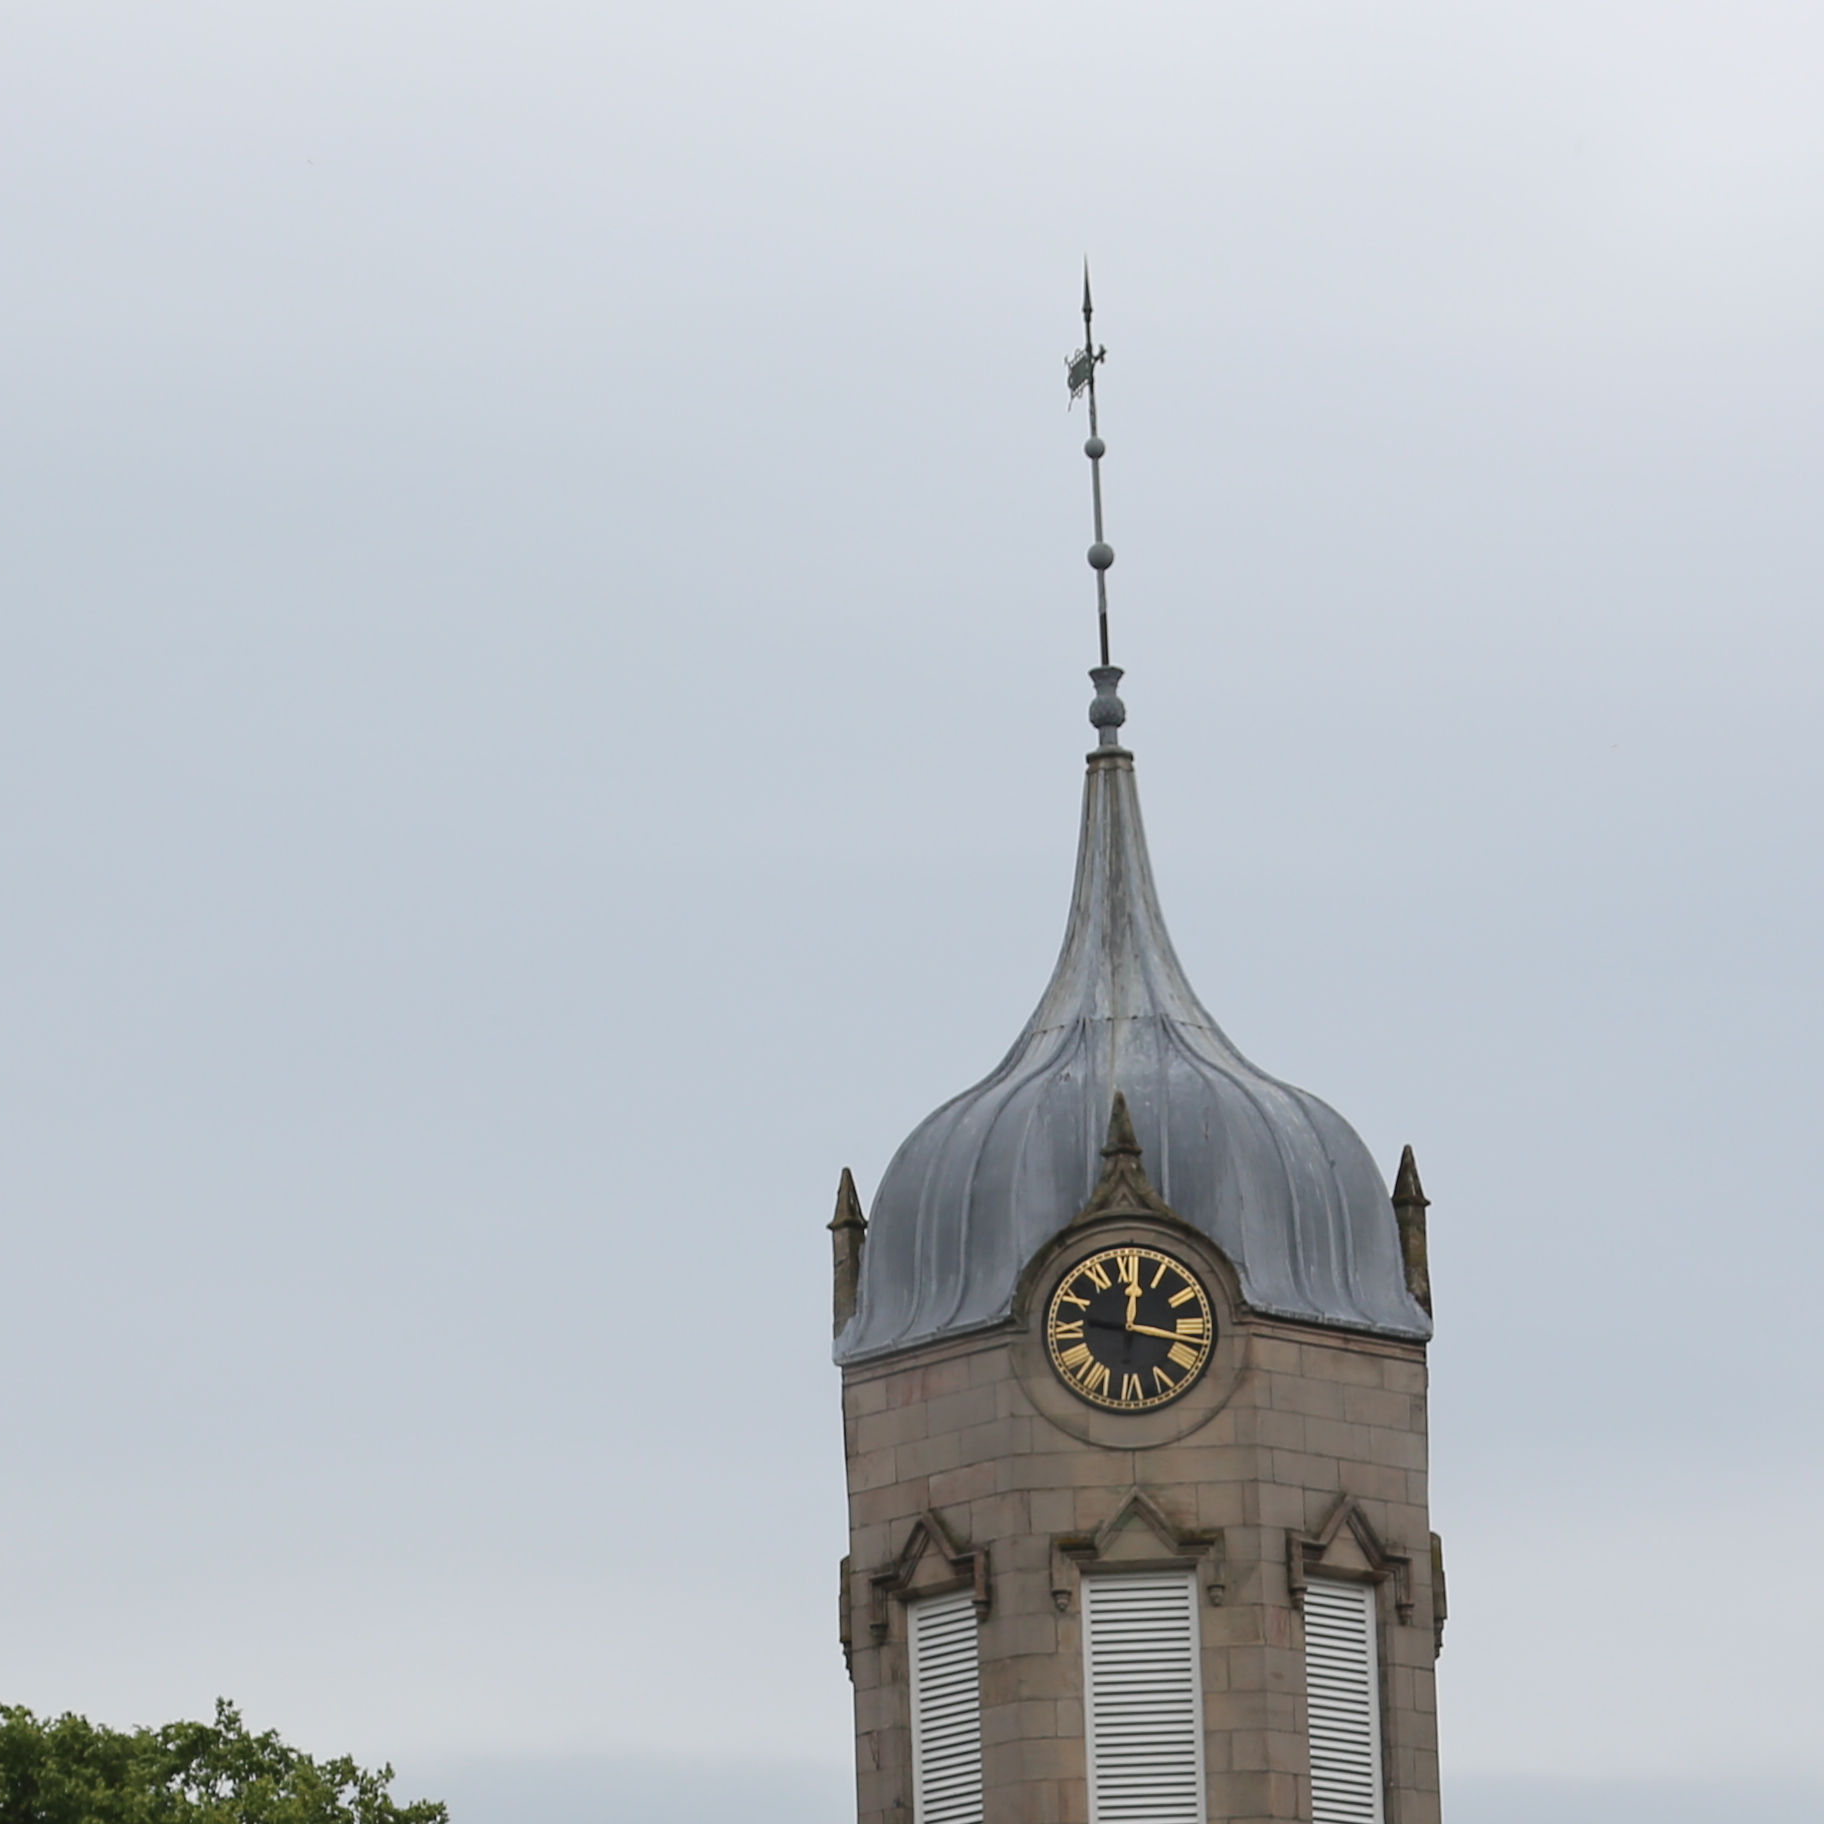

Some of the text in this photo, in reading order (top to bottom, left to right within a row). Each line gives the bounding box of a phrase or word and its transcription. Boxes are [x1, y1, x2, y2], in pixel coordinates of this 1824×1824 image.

[1084, 1262, 1112, 1294] XI
[1150, 1263, 1167, 1289] I
[1062, 1288, 1091, 1312] X
[1168, 1286, 1196, 1309] II
[1055, 1319, 1084, 1339] IX
[1176, 1317, 1203, 1334] III
[1060, 1342, 1094, 1381] VIII
[1083, 1361, 1111, 1397] VII
[1121, 1372, 1144, 1400] VI
[1152, 1365, 1176, 1394] V
